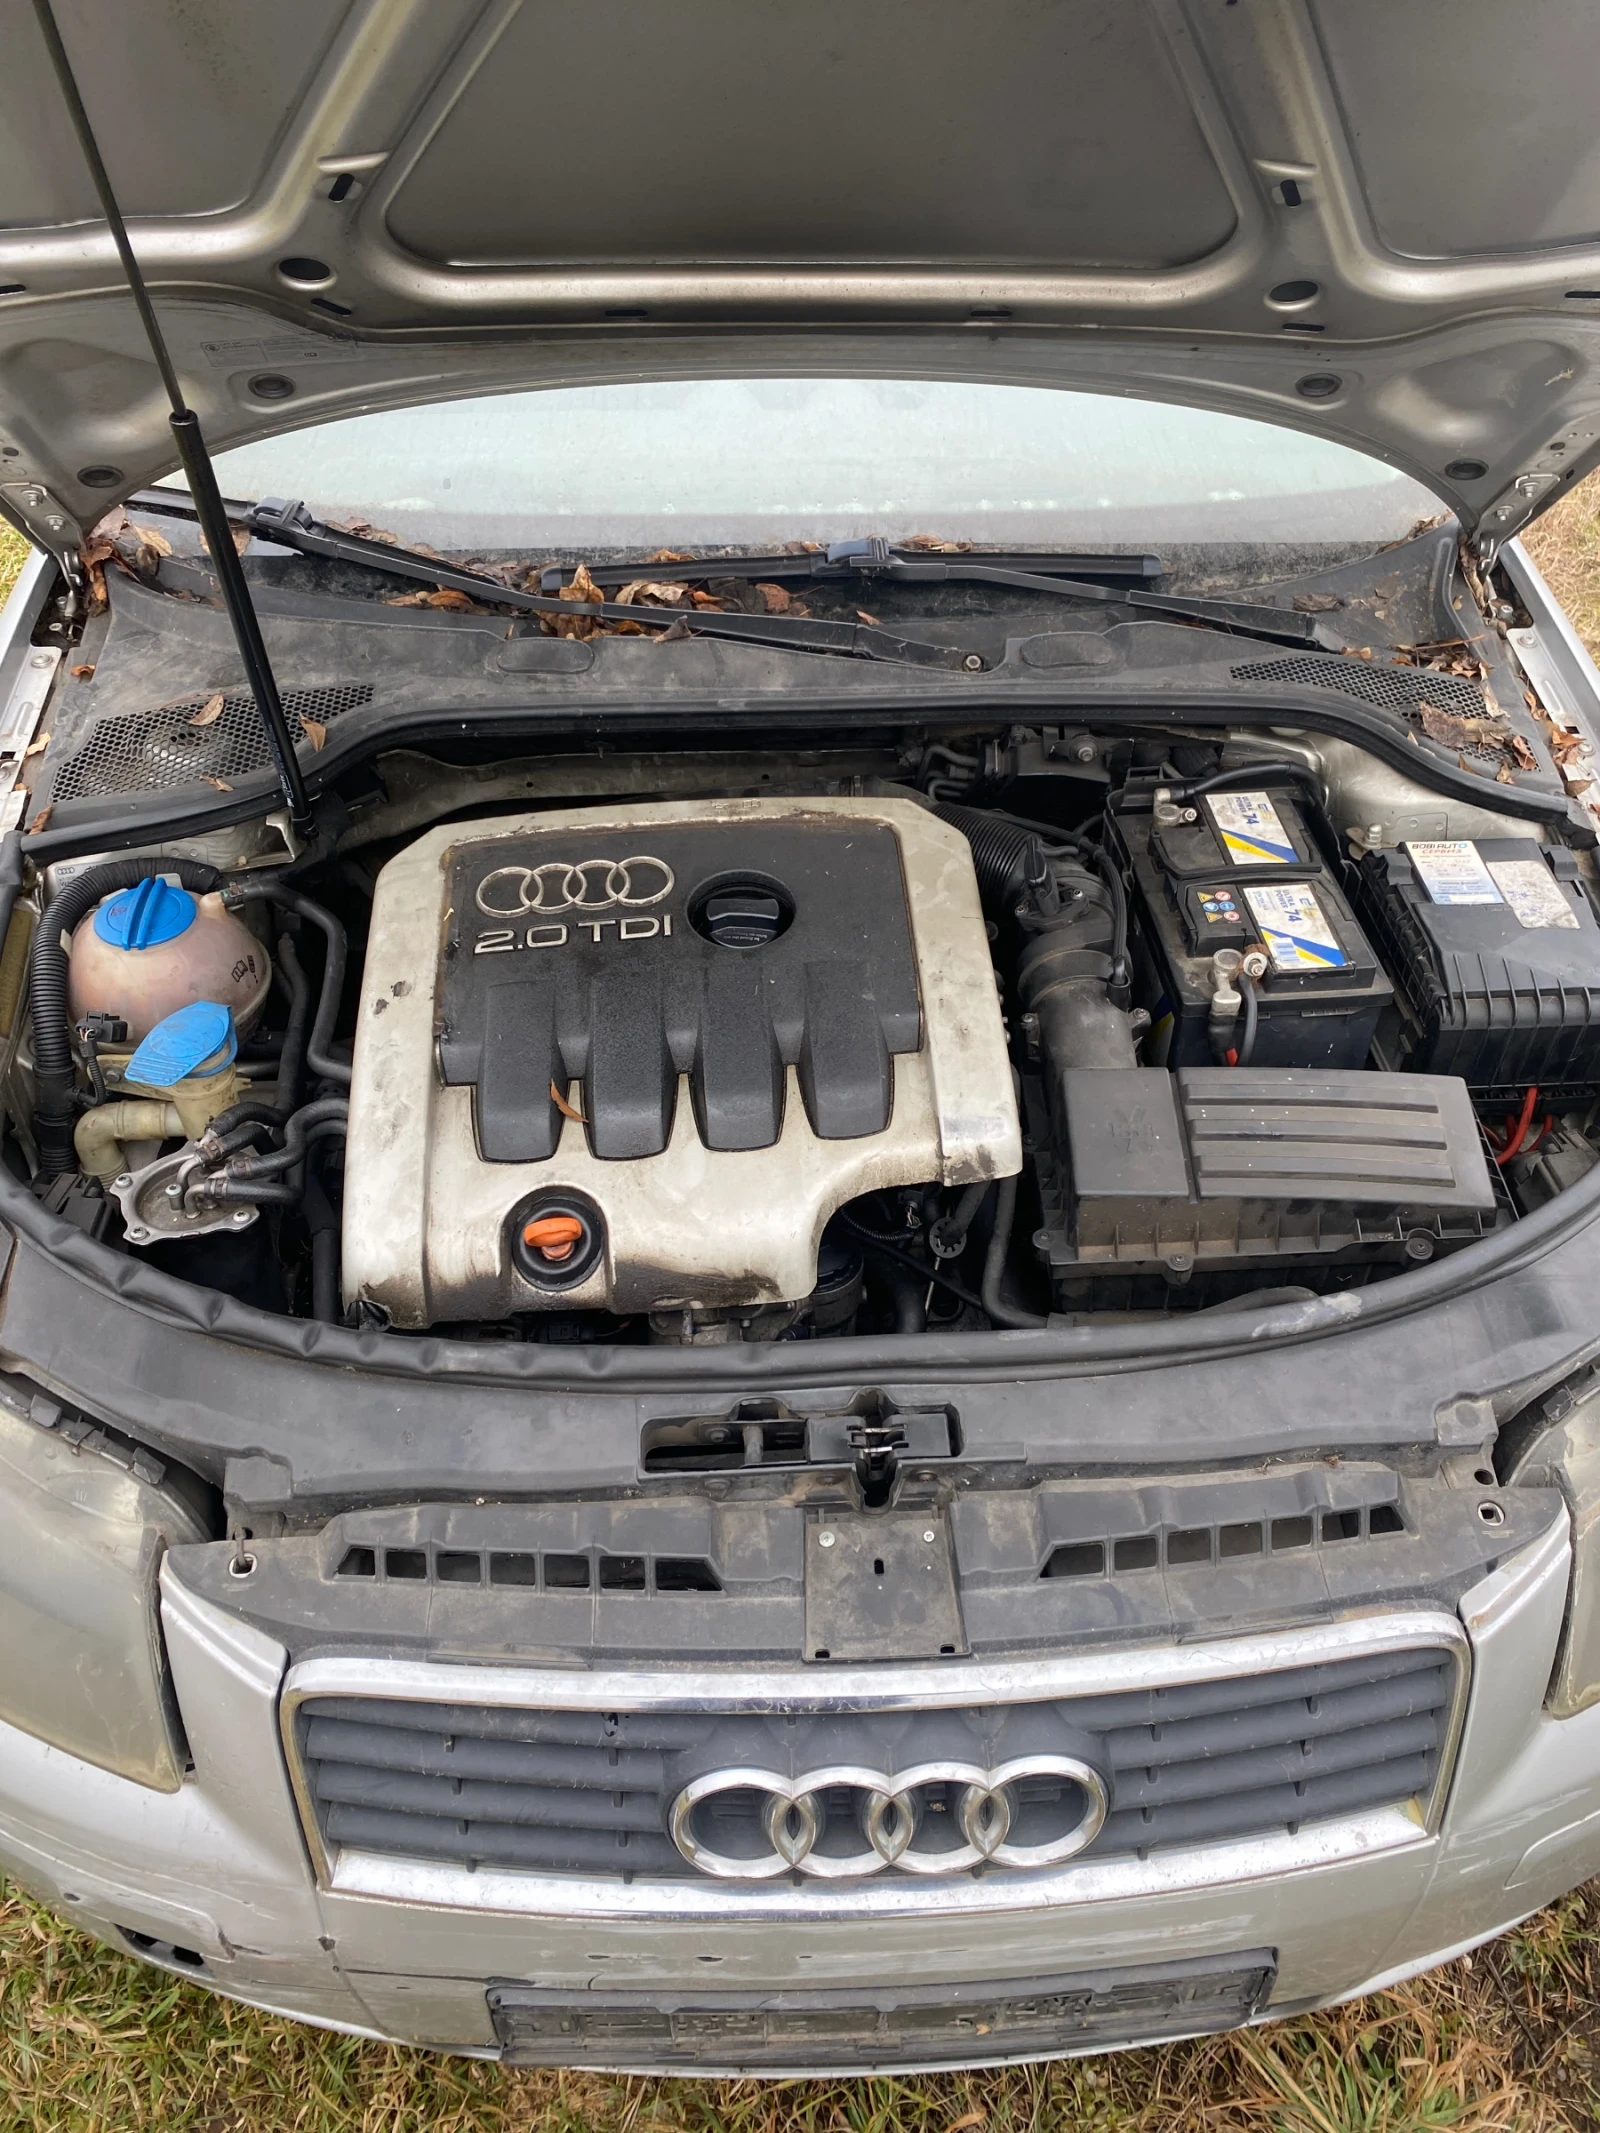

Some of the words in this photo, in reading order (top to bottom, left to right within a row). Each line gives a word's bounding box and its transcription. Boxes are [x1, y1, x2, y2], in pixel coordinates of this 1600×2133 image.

[1235, 796, 1247, 813] POWER
[1242, 796, 1253, 810] ULTRA
[1242, 813, 1260, 825] 74
[1275, 889, 1289, 909] POWER
[1283, 889, 1295, 907] ULTRA
[1284, 909, 1303, 922] 74
[474, 924, 568, 955] 2.0
[577, 914, 673, 943] TDI
